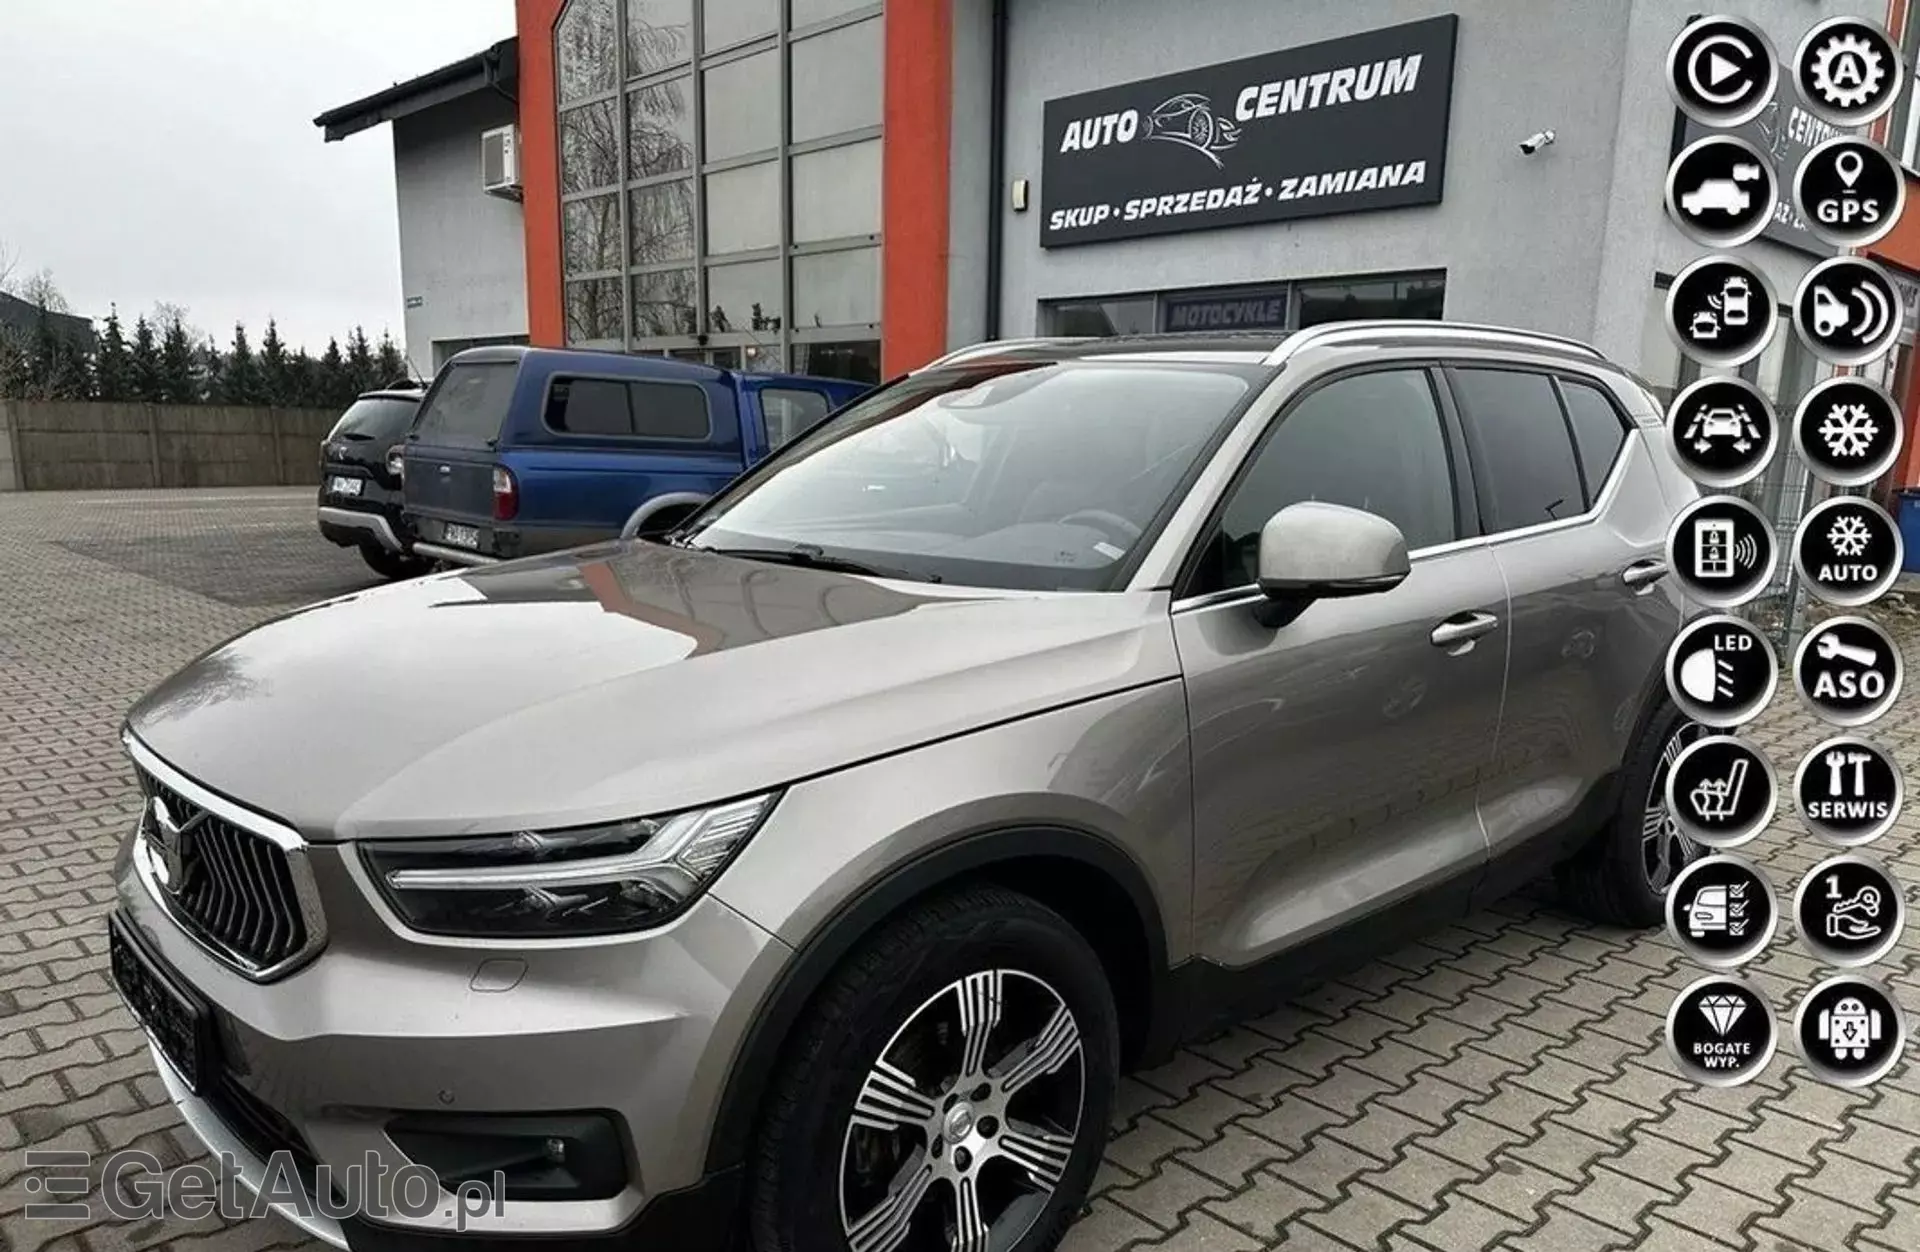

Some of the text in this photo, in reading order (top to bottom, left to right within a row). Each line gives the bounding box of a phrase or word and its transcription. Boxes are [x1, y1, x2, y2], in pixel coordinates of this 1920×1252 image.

[1060, 54, 1422, 152] AUTO CENTRUM
[1049, 161, 1426, 230] SKUP SPRZEDAŻ ZAMIANA
[1170, 299, 1281, 326] MOTOCYKLE
